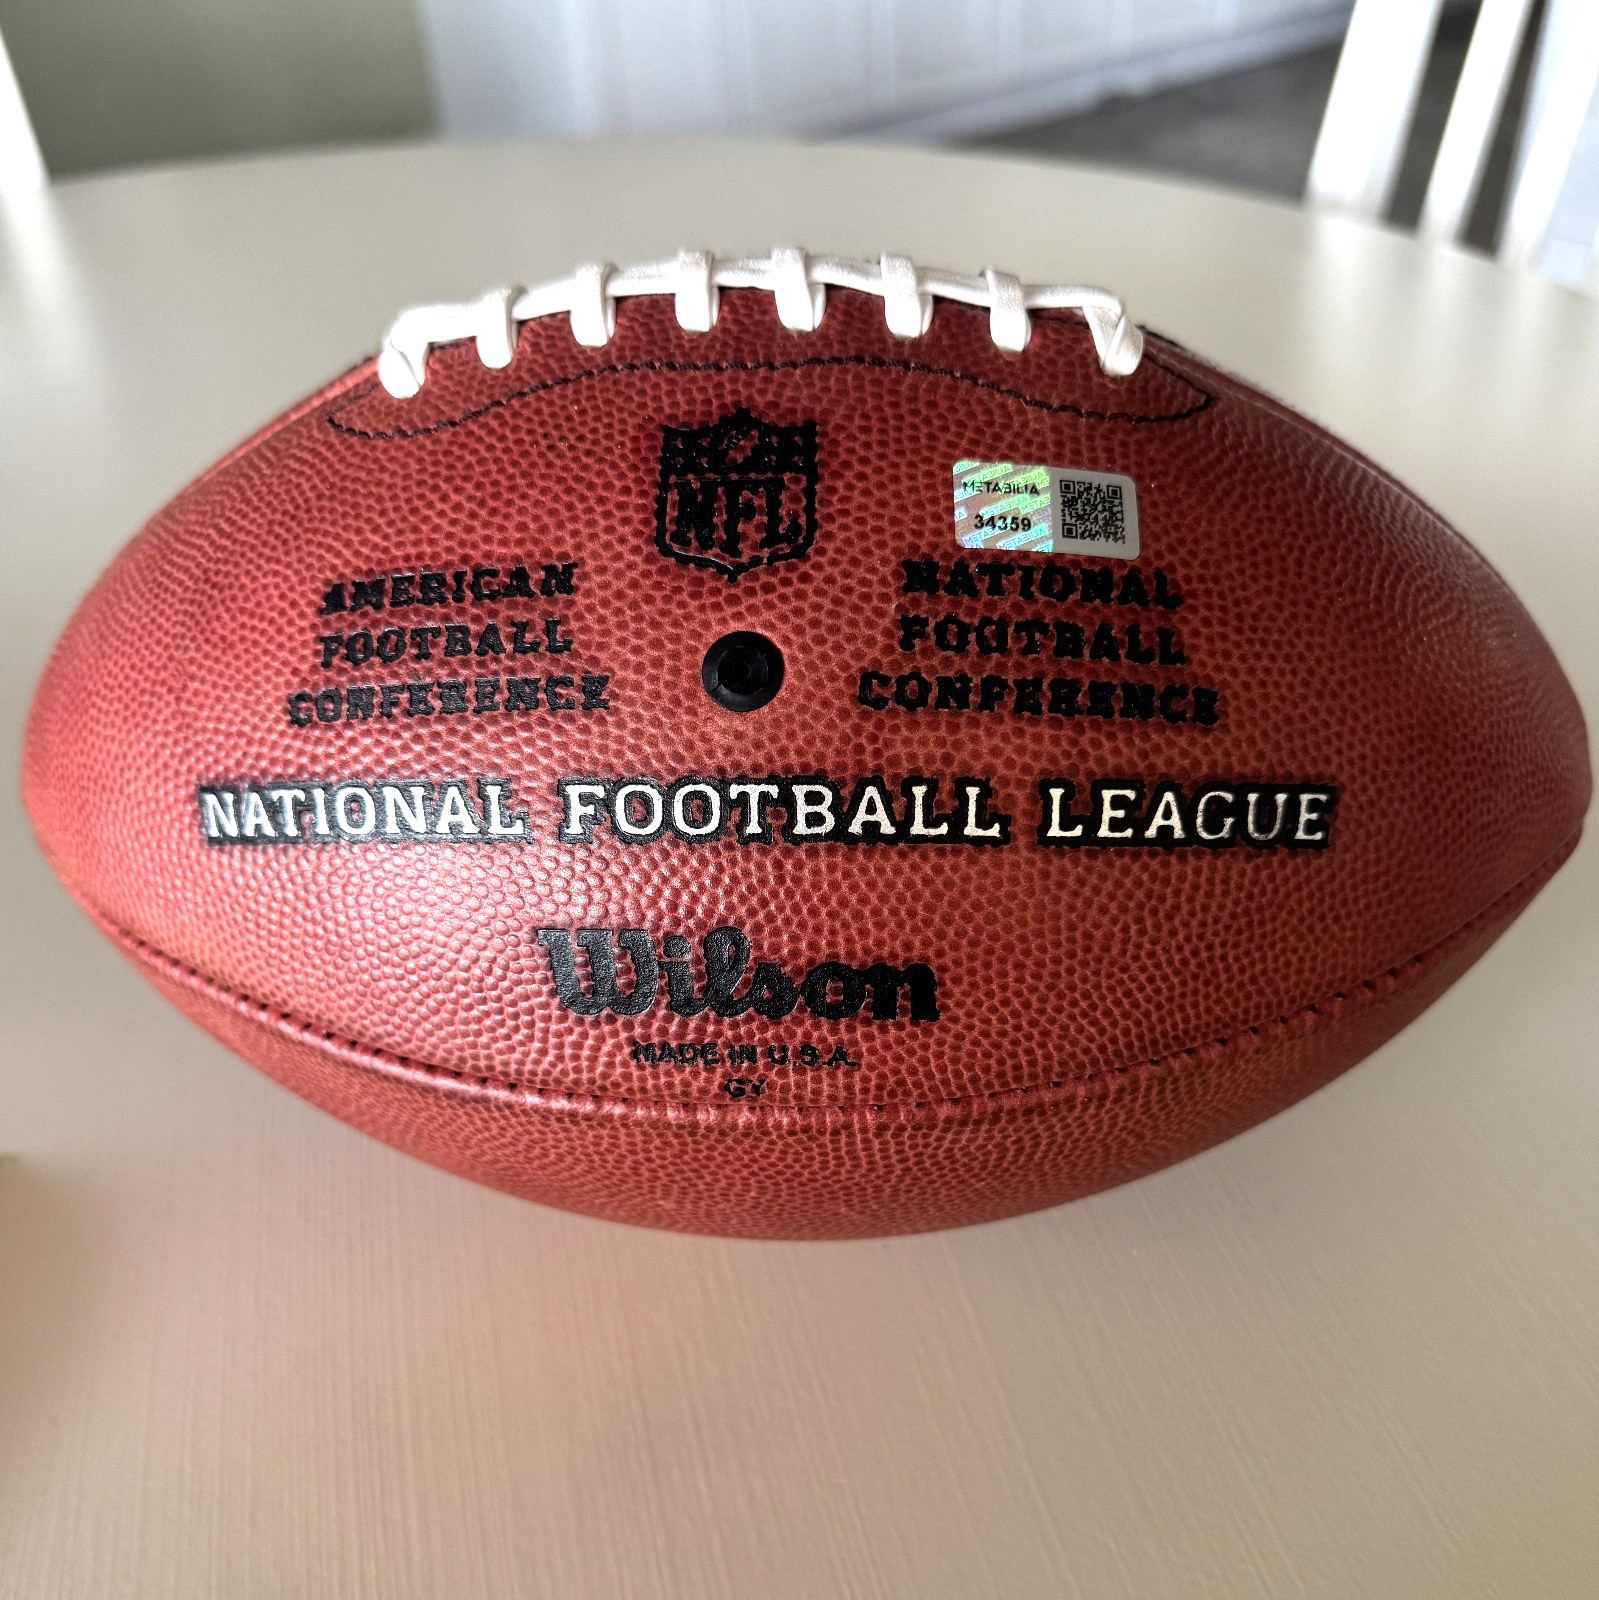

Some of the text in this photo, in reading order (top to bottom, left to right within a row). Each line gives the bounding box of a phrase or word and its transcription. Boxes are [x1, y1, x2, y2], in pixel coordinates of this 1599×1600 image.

[962, 481, 1040, 496] METABILIA
[669, 479, 803, 558] NFL
[974, 514, 1032, 532] 34359
[320, 561, 579, 616] AMERICAN
[901, 558, 1184, 610] NATIONAL
[320, 617, 573, 669] FOOTBALL
[899, 614, 1188, 666] FOOTBALL
[289, 671, 610, 728] CONFERENCE
[857, 671, 1220, 726] CONFERENCE
[200, 781, 1332, 843] NATIONAL FOOTBALL LEAGUE
[537, 925, 941, 1022] Wilson
[632, 1040, 721, 1067] MADE
[728, 1043, 758, 1067] IN
[724, 1077, 767, 1098] GY
